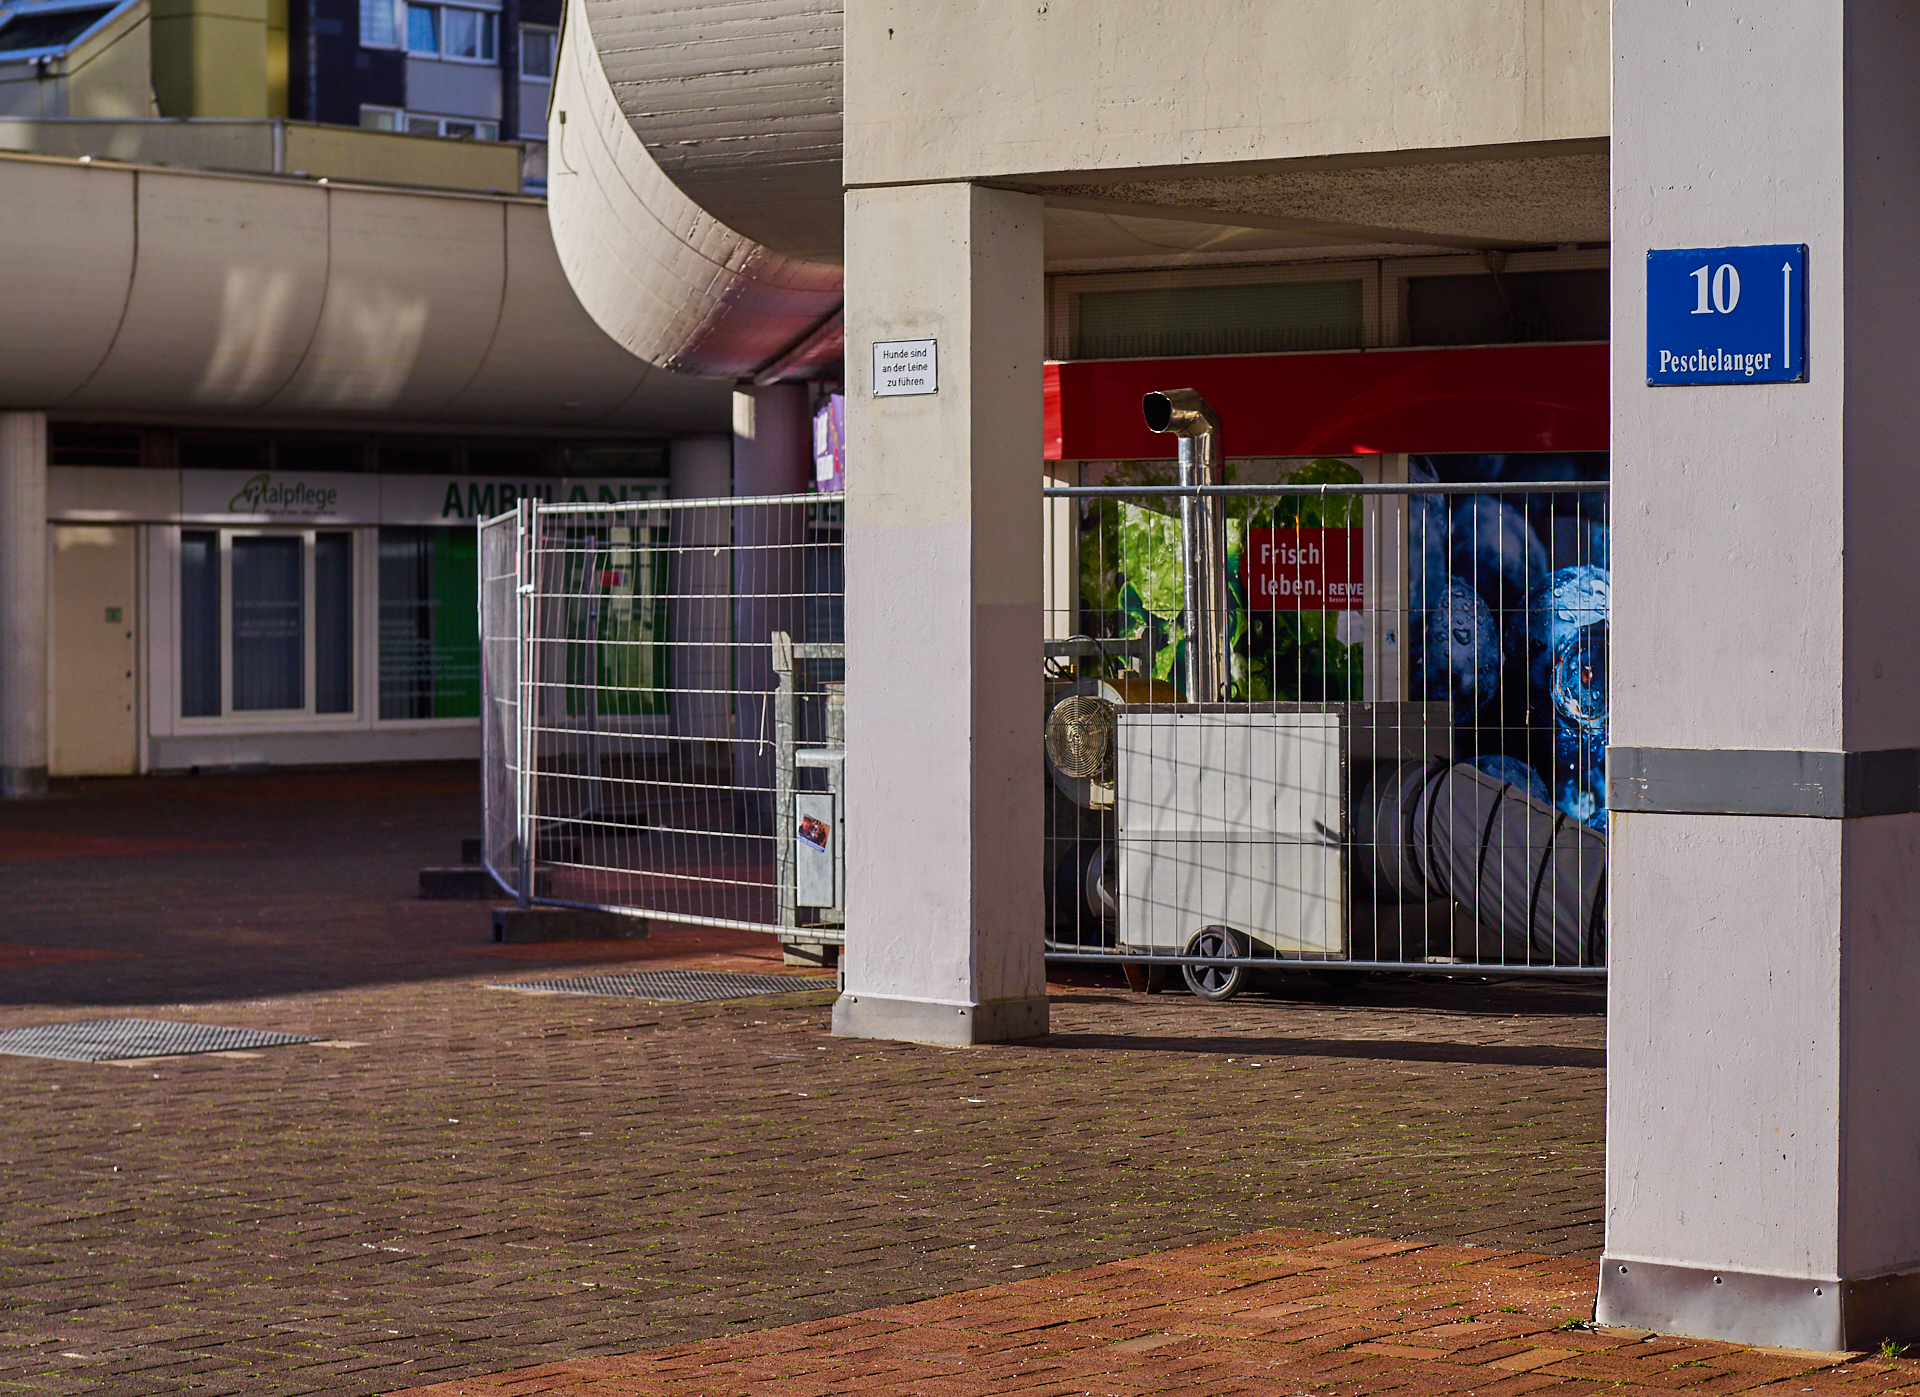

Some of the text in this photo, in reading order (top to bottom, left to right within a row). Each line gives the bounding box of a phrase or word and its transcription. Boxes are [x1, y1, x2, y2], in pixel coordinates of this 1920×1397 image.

[1689, 263, 1741, 314] 10
[883, 348, 927, 359] Hunde sind
[1659, 348, 1772, 376] Peschelanger
[893, 363, 906, 372] der
[907, 362, 928, 372] Leine
[887, 377, 924, 387] zu führen
[1261, 542, 1320, 565] Frisch
[1261, 573, 1323, 596] leben.
[1328, 583, 1364, 596] REWE
